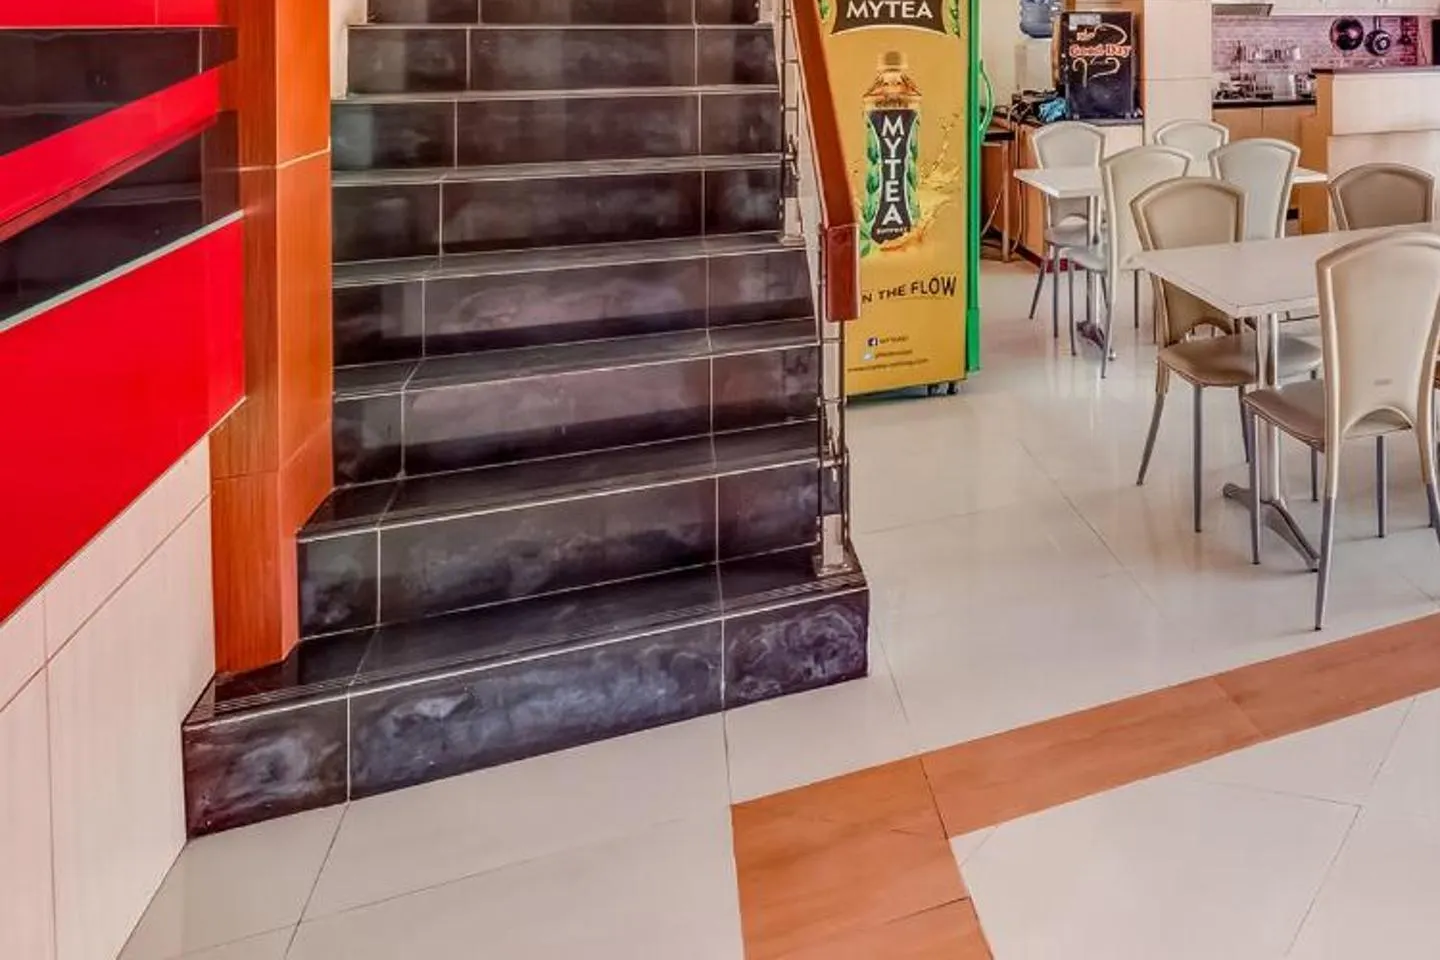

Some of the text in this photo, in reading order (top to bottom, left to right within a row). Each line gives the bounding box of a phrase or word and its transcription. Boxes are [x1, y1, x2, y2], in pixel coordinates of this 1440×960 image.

[846, 0, 934, 19] MYTEA
[882, 115, 905, 225] MYTEA
[878, 284, 908, 300] THE
[911, 276, 957, 296] FLOW
